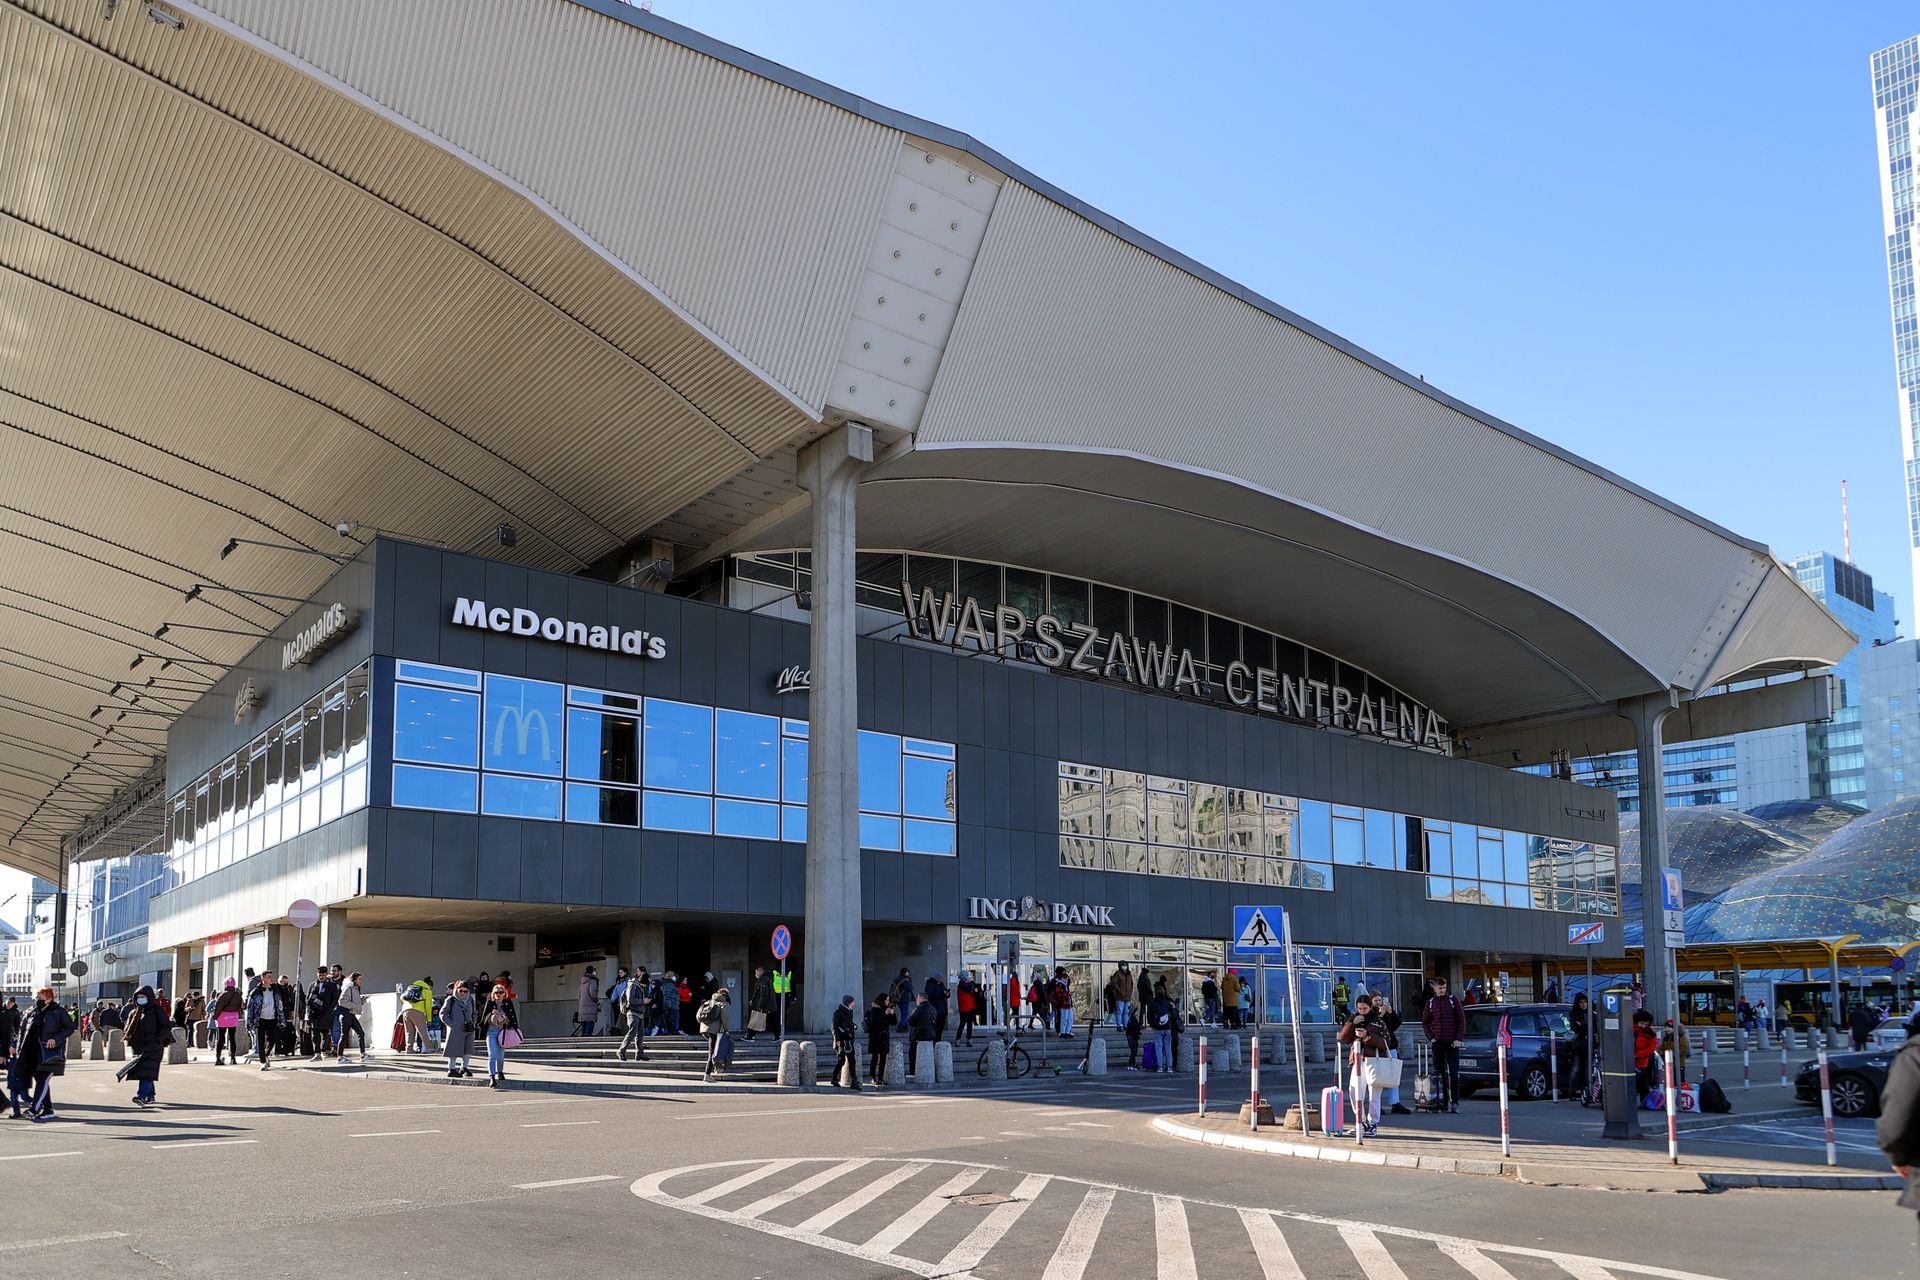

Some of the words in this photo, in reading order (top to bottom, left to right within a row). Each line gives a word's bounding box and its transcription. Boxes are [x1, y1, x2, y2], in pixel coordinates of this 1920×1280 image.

[282, 602, 346, 671] McDonald's
[452, 597, 667, 659] McDonald's
[902, 580, 1200, 695] WARSZAWA
[1226, 660, 1444, 748] CENTRALNA
[968, 897, 1019, 920] ING
[1052, 903, 1116, 926] BANK
[1570, 926, 1601, 941] TAXI
[1606, 995, 1616, 1010] P
